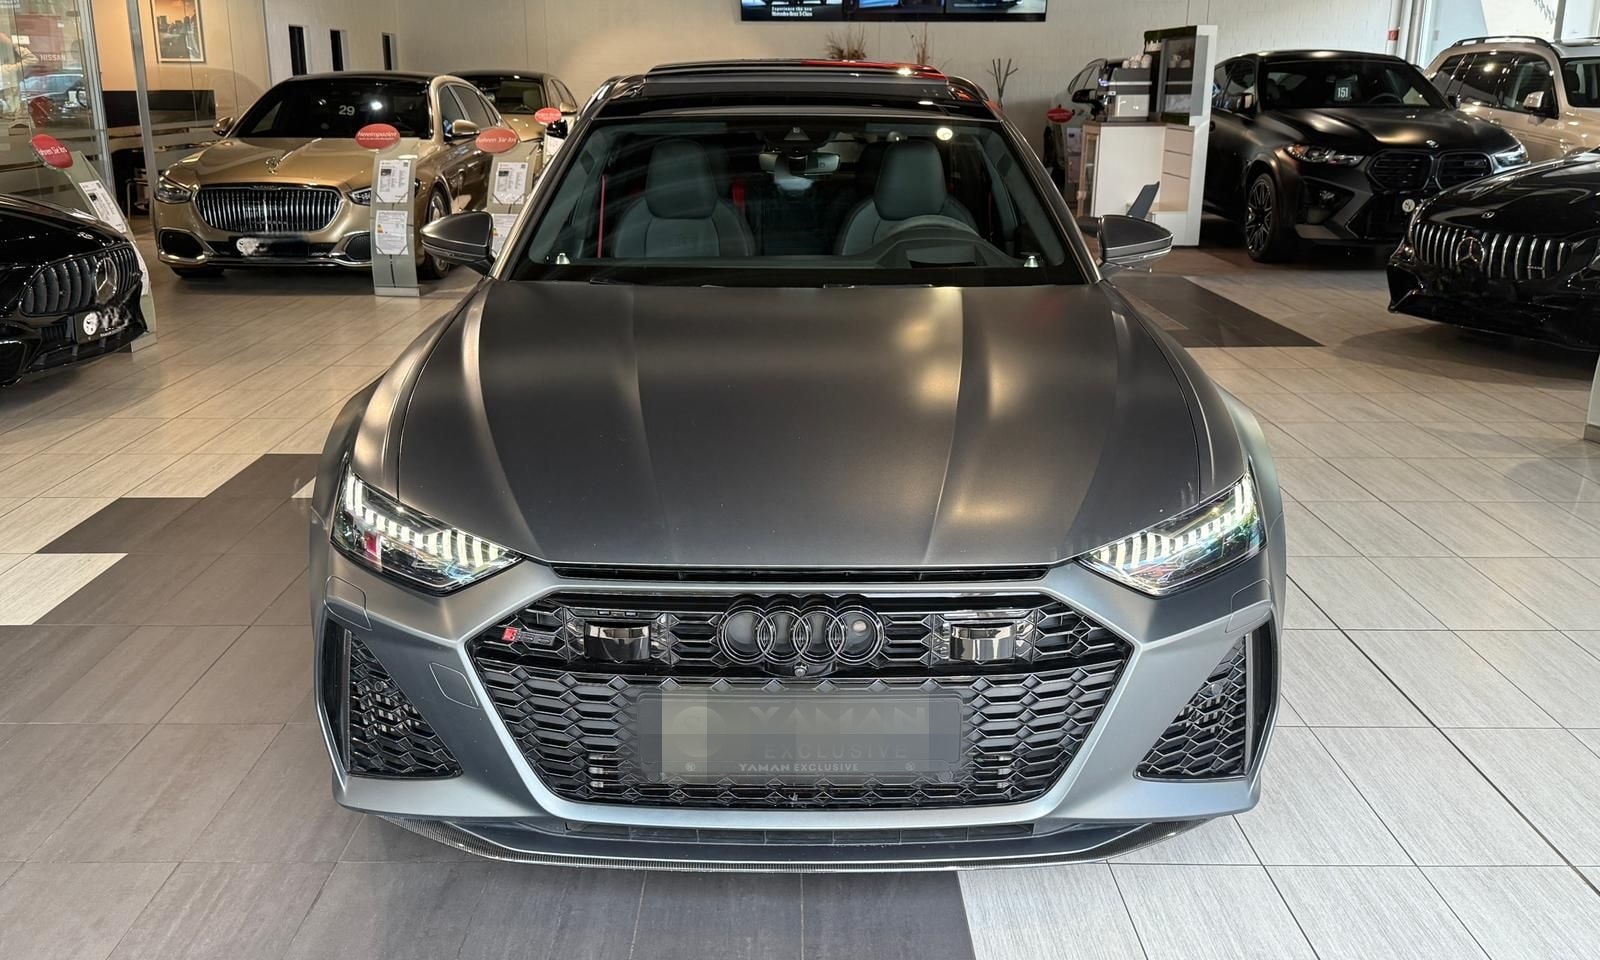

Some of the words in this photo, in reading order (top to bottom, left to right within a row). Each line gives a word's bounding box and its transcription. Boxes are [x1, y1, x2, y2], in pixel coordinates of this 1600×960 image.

[39, 53, 66, 61] NISSAN
[1337, 87, 1349, 98] 151
[338, 104, 356, 116] 29
[749, 706, 926, 733] YAMAN
[764, 743, 908, 759] EXCLUSIVE
[738, 763, 791, 772] YAMAN
[793, 763, 859, 772] EXCLUSIVE
